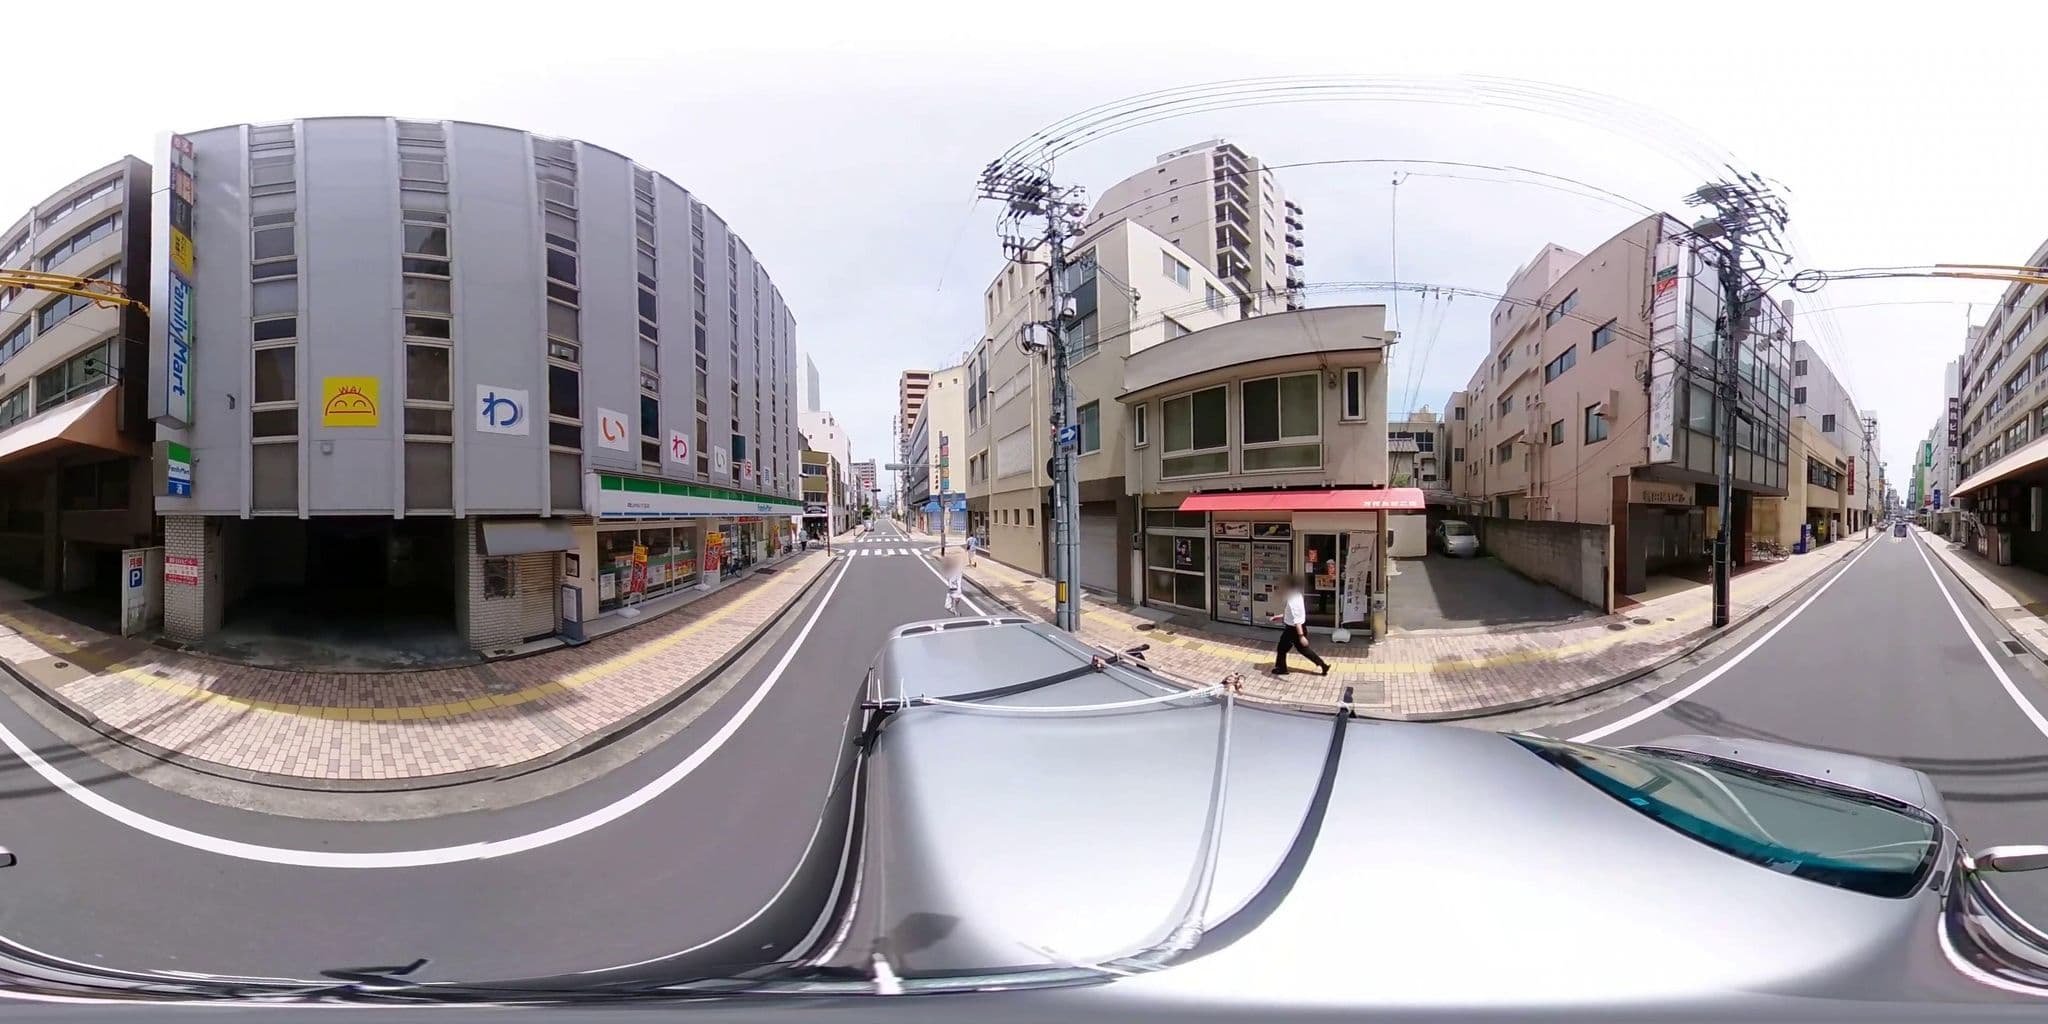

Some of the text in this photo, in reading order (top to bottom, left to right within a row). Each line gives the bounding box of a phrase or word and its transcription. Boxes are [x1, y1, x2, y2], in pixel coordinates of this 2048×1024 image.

[169, 277, 190, 397] FamilyMart
[482, 391, 519, 426] わ
[603, 416, 625, 442] い
[672, 435, 687, 459] わ
[131, 570, 141, 586] P
